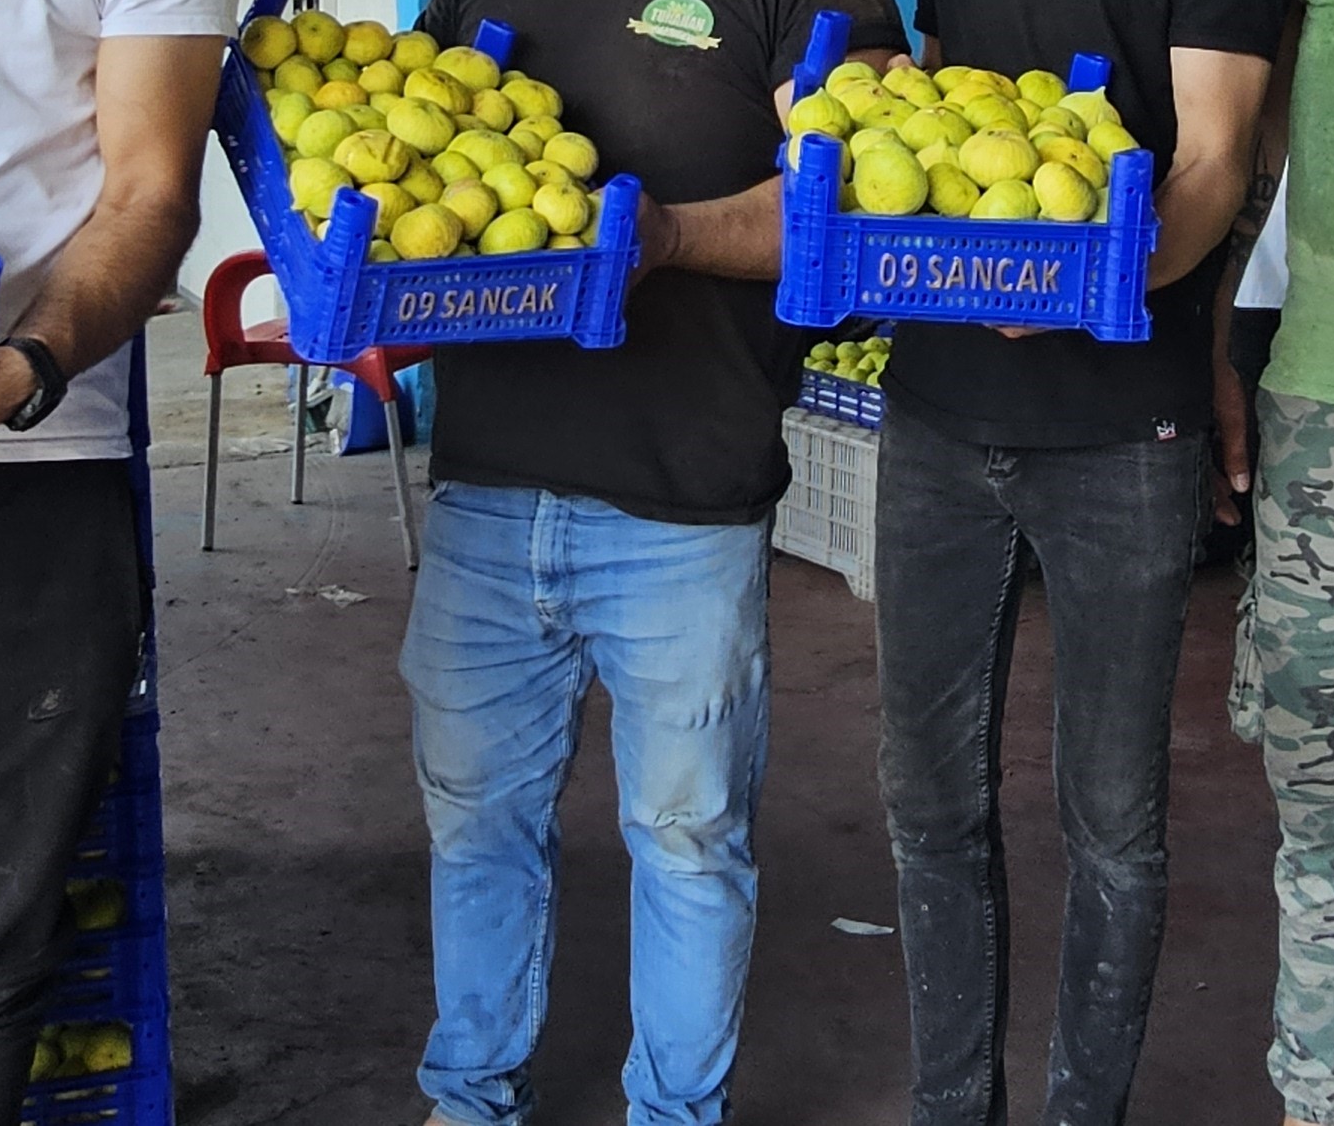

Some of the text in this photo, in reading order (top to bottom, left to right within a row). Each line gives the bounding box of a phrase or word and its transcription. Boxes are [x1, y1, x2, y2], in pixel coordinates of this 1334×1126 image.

[879, 252, 1061, 294] 09 SANCAK
[399, 283, 558, 322] 09 SANCAK
